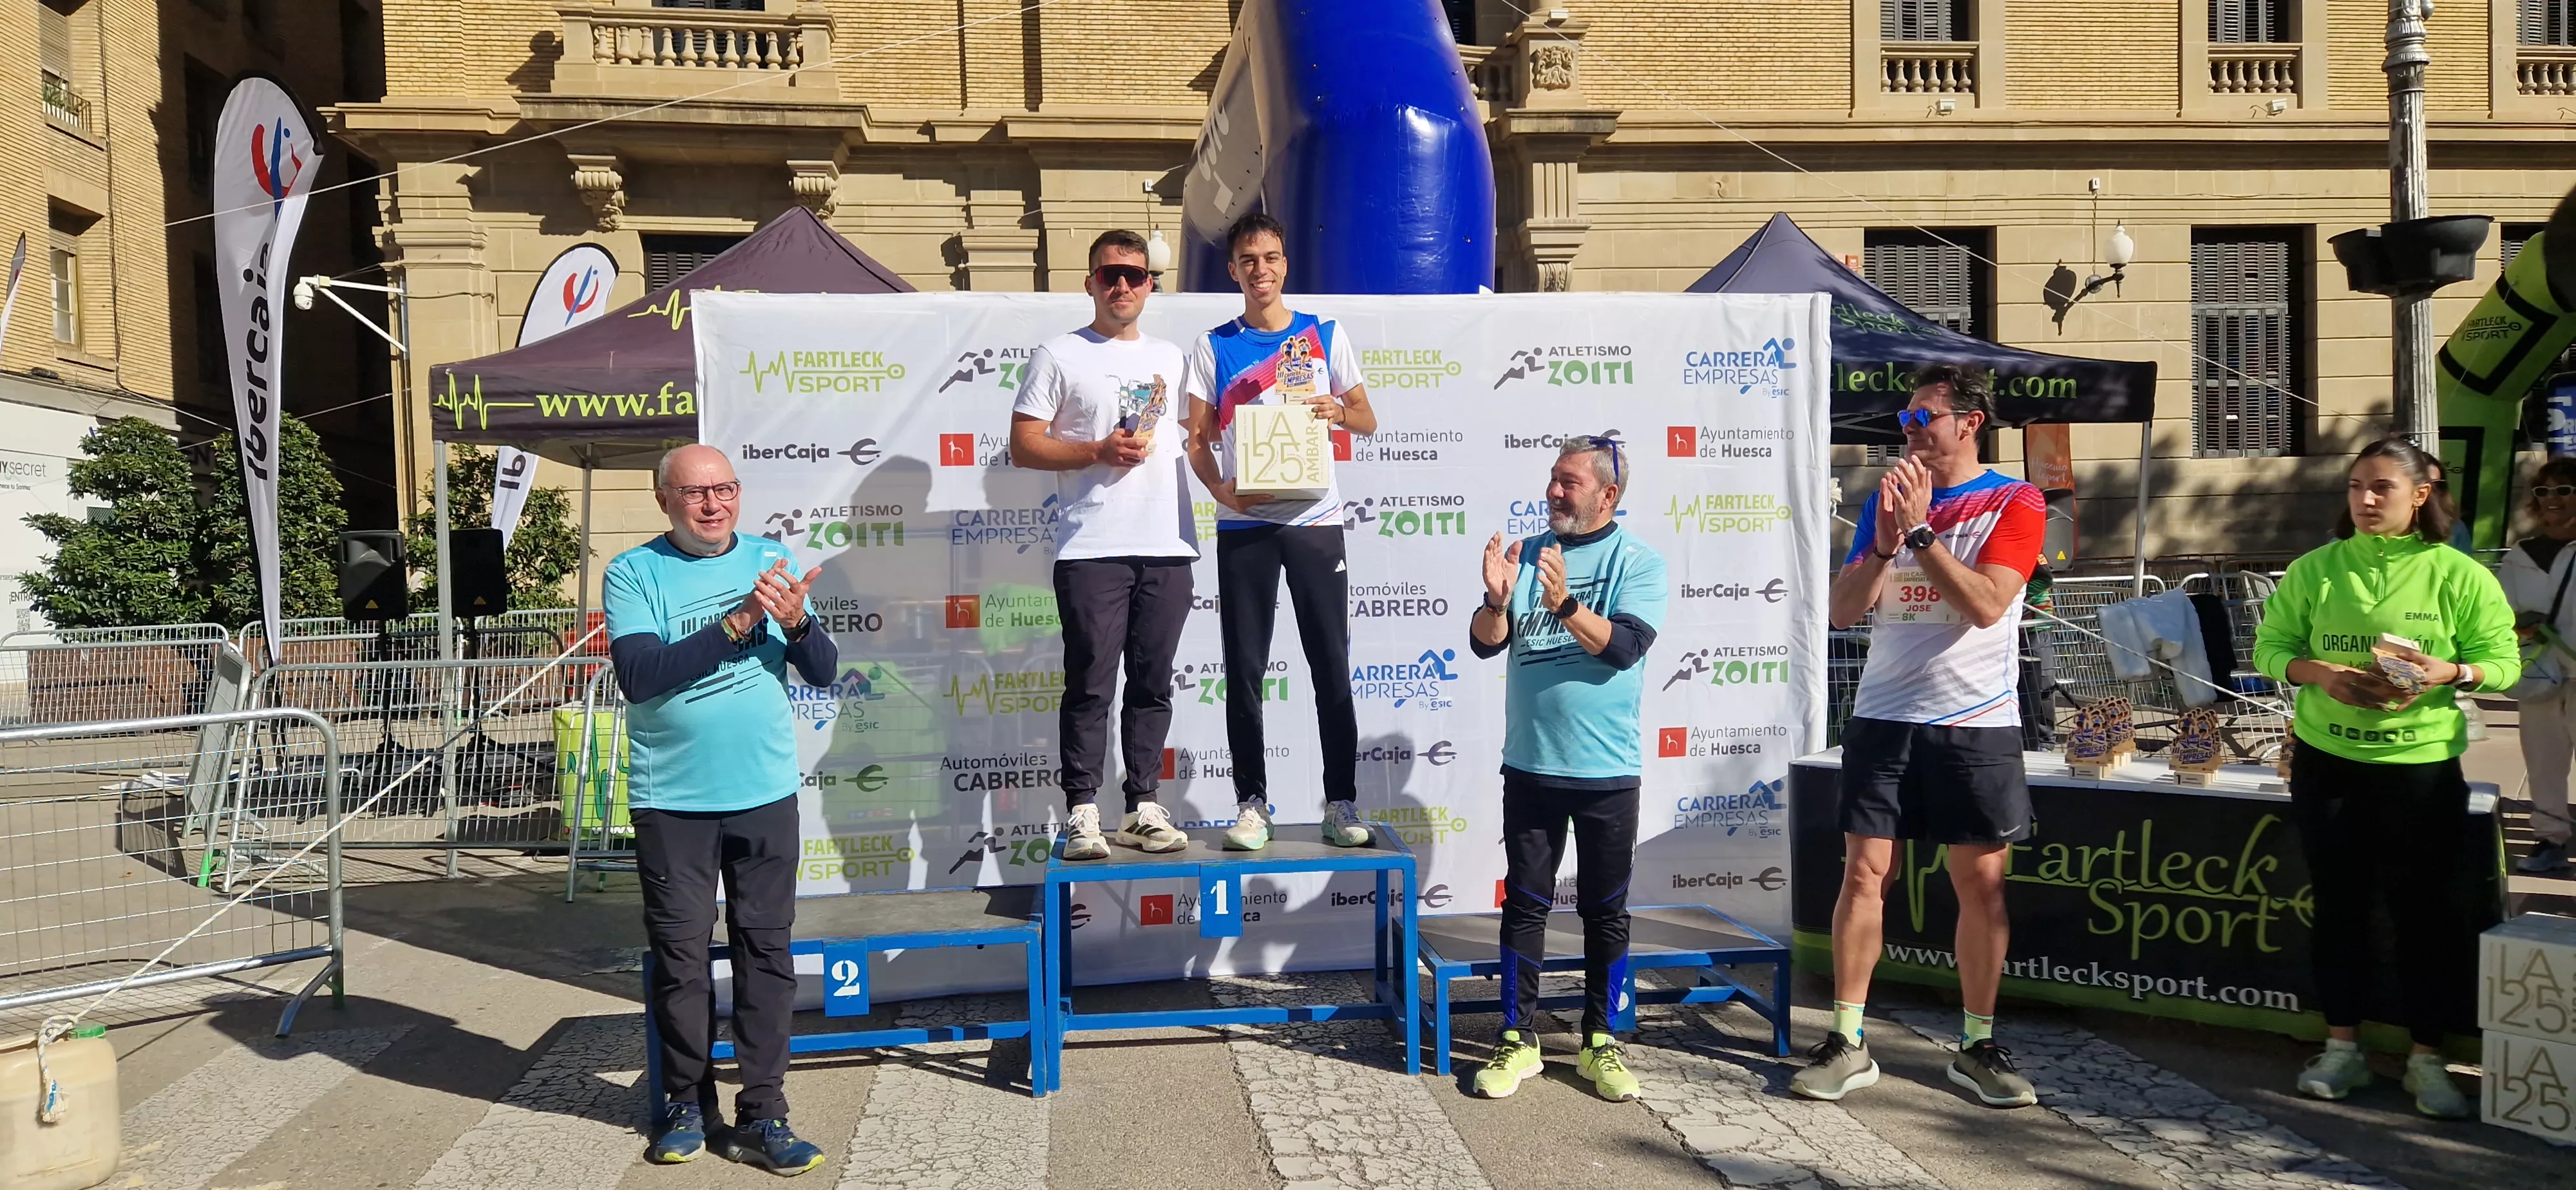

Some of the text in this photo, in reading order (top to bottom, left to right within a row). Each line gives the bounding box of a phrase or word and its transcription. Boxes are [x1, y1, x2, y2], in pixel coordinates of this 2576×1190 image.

[2465, 330, 2509, 341] SPORT
[793, 351, 884, 368] FARTLECK
[1362, 350, 1443, 365] FARTLECK
[1548, 345, 1632, 357] ATLETISMO
[1685, 351, 1778, 368] CARRERA
[1366, 373, 1444, 388] SPORT
[1548, 360, 1634, 387] ZOITI
[1683, 368, 1779, 386] EMPRESAS
[799, 375, 886, 393] SPORT
[1355, 429, 1464, 446] Ayuntamiento
[1700, 426, 1795, 443] Ayuntamiento
[742, 444, 830, 463] iberCaja
[1305, 424, 1320, 484] AMBAR
[1356, 447, 1438, 462] de Huesca
[1700, 443, 1772, 458] de Huesca
[0, 460, 47, 478] Ysecret
[978, 453, 998, 467] de
[1242, 442, 1303, 484] 125
[1379, 495, 1465, 507] ATLETISMO
[1705, 495, 1776, 511] FARTLECK
[810, 504, 903, 519] ATLETISMO
[955, 509, 1059, 527] CARRERA
[1378, 511, 1466, 539] ZOITI
[1708, 517, 1774, 534] SPORT
[806, 520, 904, 551] ZOITI
[952, 527, 1059, 546] EMPRESA
[1350, 581, 1426, 596] tomóviles
[1681, 583, 1750, 601] iberCaja
[1899, 585, 1941, 603] 398
[820, 613, 883, 633] RERO
[985, 611, 1061, 628] de Huesc
[1902, 612, 1916, 621] 8K
[2405, 612, 2440, 622] EMMA
[681, 616, 697, 636] III
[1713, 645, 1788, 657] ATLETISMO
[713, 653, 750, 674] HUESCA
[1351, 663, 1439, 682] ARRERA
[1710, 659, 1790, 687] ZOITI
[789, 682, 861, 701] RRERA
[1351, 680, 1440, 699] MPRESAS
[1690, 724, 1787, 743] Ayuntamiento
[1355, 746, 1411, 764] erCaja
[1689, 742, 1761, 757] de Huesca
[940, 753, 1047, 771] Automóviles
[1179, 766, 1197, 780] de
[1677, 793, 1768, 813] CARRERA
[1369, 806, 1449, 823] FARTLECK
[1674, 809, 1768, 830] EMPRESAS
[804, 835, 894, 856] FARTLECK
[809, 860, 895, 882] SPORT
[1672, 873, 1743, 891] iberCaja
[1210, 880, 1229, 914] 1
[1177, 911, 1195, 925] de
[2088, 878, 2283, 960] Sport
[831, 959, 860, 997] 2
[2486, 976, 2568, 1034] 125
[2490, 1072, 2571, 1132] 125
